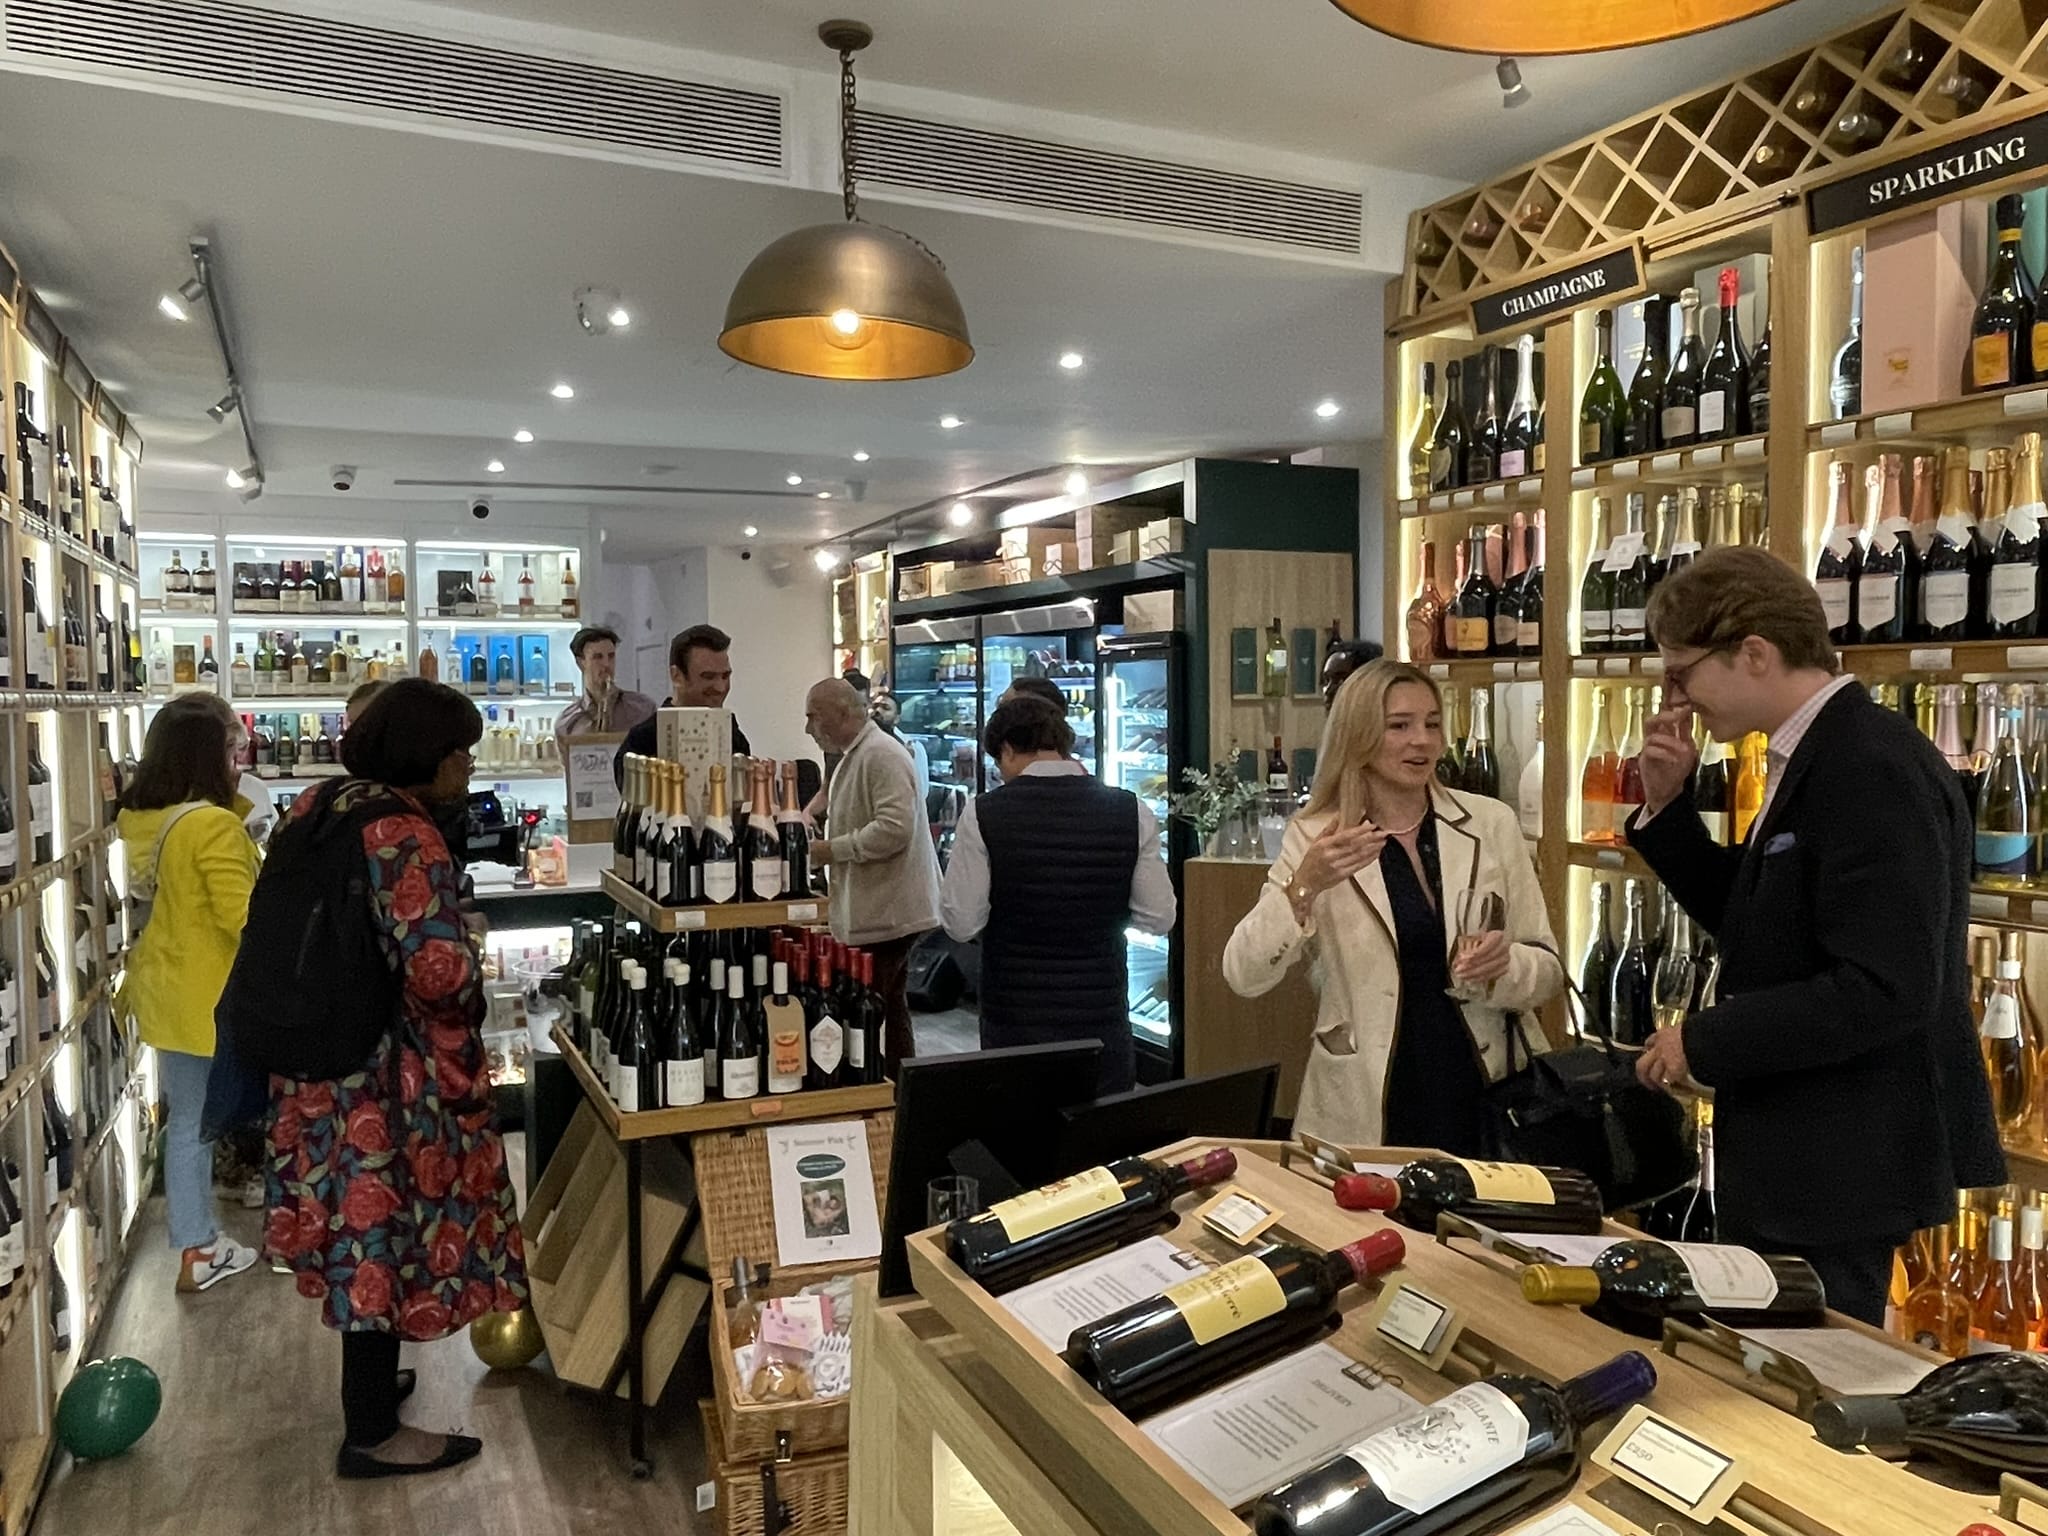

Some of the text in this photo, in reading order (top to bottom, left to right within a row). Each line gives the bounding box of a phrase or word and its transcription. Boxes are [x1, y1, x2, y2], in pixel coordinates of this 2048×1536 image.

[1869, 136, 2026, 204] SPARKLING
[1502, 269, 1606, 317] CHAMPAGNE
[1625, 1442, 1654, 1462] £250
